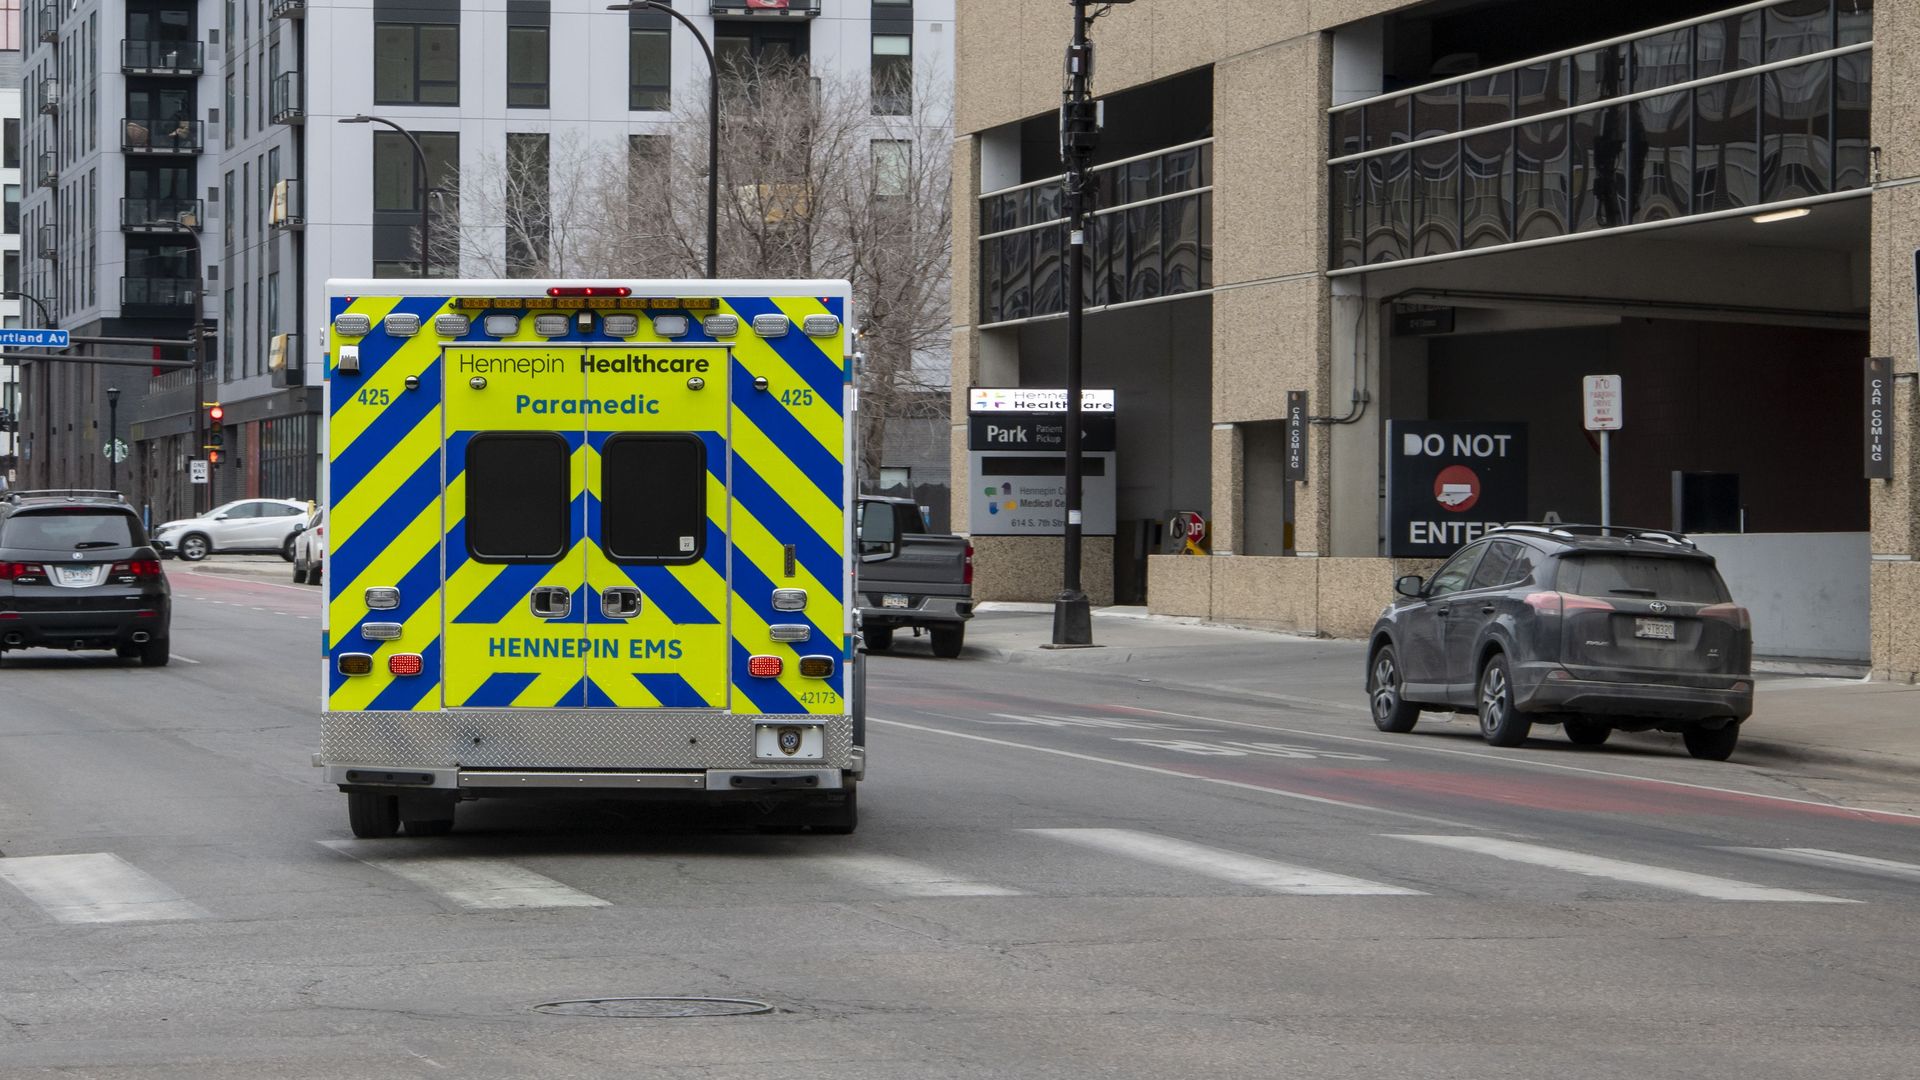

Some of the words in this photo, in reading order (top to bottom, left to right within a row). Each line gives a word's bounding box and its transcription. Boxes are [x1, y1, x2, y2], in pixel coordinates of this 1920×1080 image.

[0, 333, 43, 343] rtland
[48, 334, 66, 343] Av
[460, 353, 564, 378] Hennepin
[580, 354, 710, 374] Healthcare
[358, 388, 390, 406] 425
[781, 388, 813, 406] 425
[1014, 390, 1095, 400] Hennein
[1871, 379, 1882, 405] CAR
[516, 394, 660, 415] Paramedic
[1291, 407, 1301, 427] CAR
[987, 425, 1028, 442] Park
[1036, 424, 1063, 433] Patient
[1871, 409, 1883, 462] COMING
[1036, 434, 1061, 444] Pickup
[1403, 433, 1445, 456] DO
[1453, 434, 1511, 457] NOT
[1290, 429, 1300, 469] COMING
[1011, 519, 1026, 527] 614
[1038, 519, 1051, 527] 7th
[489, 637, 619, 658] HENNEPIN
[629, 639, 683, 659] EMS
[800, 692, 836, 704] 42173
